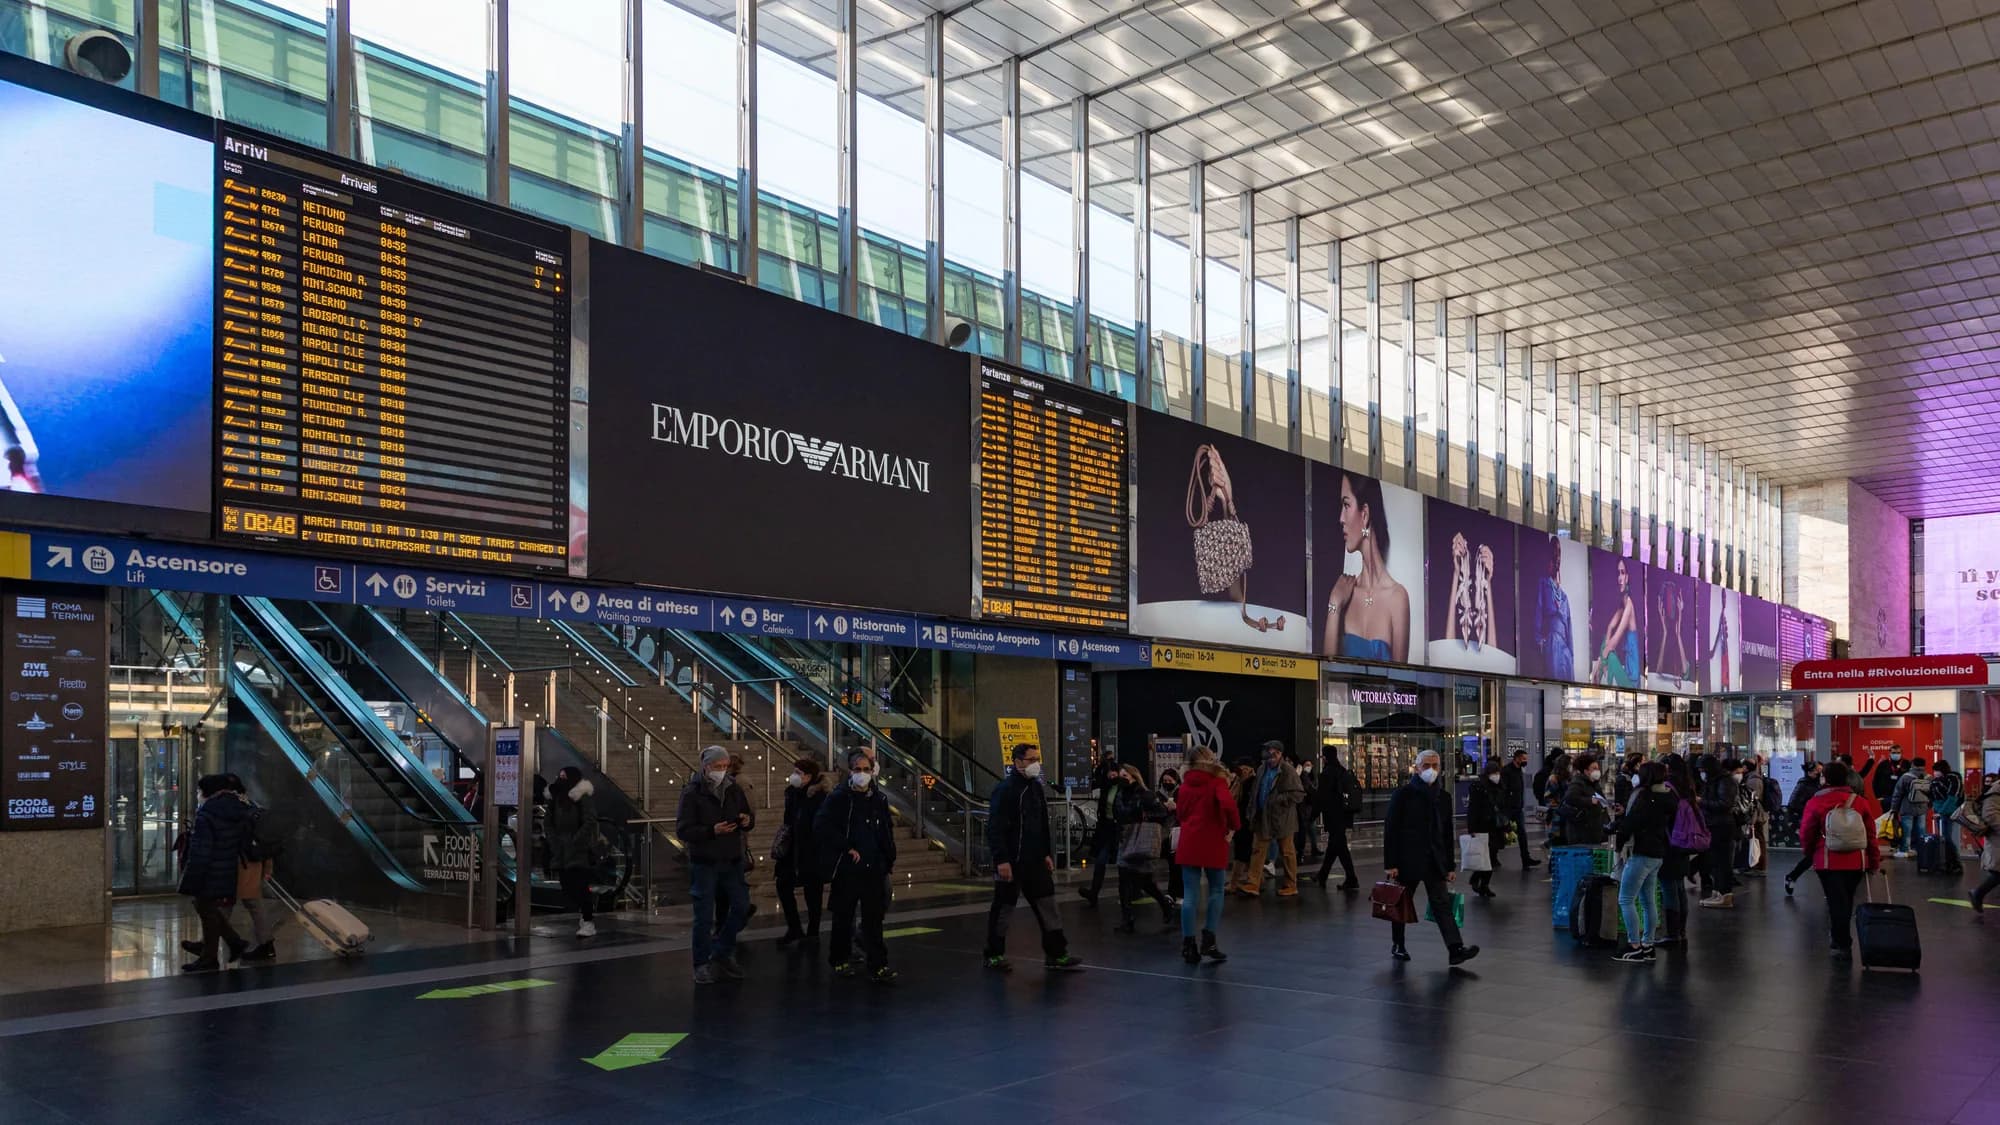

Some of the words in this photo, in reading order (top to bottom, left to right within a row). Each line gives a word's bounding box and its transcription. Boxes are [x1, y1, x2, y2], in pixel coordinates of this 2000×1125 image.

[225, 136, 268, 161] Arrivi
[340, 173, 378, 194] Arrivals
[303, 200, 346, 221] NETTUNO
[380, 223, 406, 238] 08:48
[535, 266, 544, 276] 17
[303, 231, 338, 249] LATINA
[380, 252, 406, 267] 08:54
[303, 216, 345, 236] PERUGIA
[380, 237, 406, 252] 08:52
[534, 279, 540, 289] 3
[303, 246, 345, 265] PERUGIA
[380, 266, 406, 281] 08:55
[303, 261, 352, 282] FIUMICINO
[358, 275, 368, 286] A.
[380, 281, 406, 295] 08:55
[303, 291, 346, 310] SALERNO
[303, 306, 355, 327] LADISPOLI
[303, 321, 338, 338] MILANO
[303, 337, 338, 353] NAPOLI
[303, 352, 338, 368] NAPOLI
[303, 368, 350, 385] FRASCATI
[982, 365, 1010, 382] Partenze
[303, 383, 338, 397] MILANO
[303, 397, 352, 415] FIUMICINO
[303, 413, 345, 428] NETTUNO
[303, 428, 351, 445] MONTALTO
[303, 443, 338, 457] MILANO
[651, 403, 794, 464] EMPORIO
[831, 443, 930, 493] ARMANI
[303, 473, 338, 487] MILANO
[244, 512, 296, 534] 08:48
[304, 516, 336, 528] MARCH
[342, 520, 366, 532] FROM
[372, 524, 382, 534] 10
[387, 526, 399, 536] AM
[405, 528, 416, 537] TO
[421, 530, 438, 540] 1:30
[444, 532, 455, 542] PM
[460, 534, 482, 546] SOME
[487, 538, 515, 550] TRAINS
[520, 542, 554, 554] CHANGED
[317, 532, 357, 546] VIETATO
[363, 537, 431, 554] OLTREPASSARE
[436, 545, 448, 556] LA
[452, 547, 477, 559] LINEA
[482, 551, 511, 563] GIALLA
[126, 549, 247, 576] Ascensore
[127, 570, 146, 583] Lift
[426, 576, 485, 597] Servizi
[52, 602, 81, 611] ROMA
[425, 595, 456, 607] Toilets
[597, 593, 633, 609] Area
[638, 596, 652, 611] di
[656, 601, 698, 615] attesa
[52, 611, 94, 621] TERMINI
[597, 610, 629, 624] Waiting
[632, 615, 651, 623] area
[762, 609, 784, 623] Bar
[762, 624, 794, 635] Cafeteria
[852, 618, 906, 634] Ristorante
[852, 632, 884, 641] Restaurant
[951, 627, 994, 642] Fiumicino
[997, 632, 1040, 647] Aeroporto
[951, 641, 976, 650] Fiumicino
[977, 644, 995, 652] Airport
[1082, 640, 1120, 653] Ascensore
[1176, 649, 1194, 659] Binari
[1198, 651, 1214, 661] 16-24
[1262, 658, 1278, 667] Binari
[24, 662, 46, 670] FIVE
[1804, 670, 1833, 679] Entra
[1837, 669, 1864, 678] nella
[1858, 692, 1912, 712] iliad
[59, 762, 86, 770] STYLE
[9, 806, 55, 814] LOUNGE
[424, 869, 454, 880] TERRAZZA
